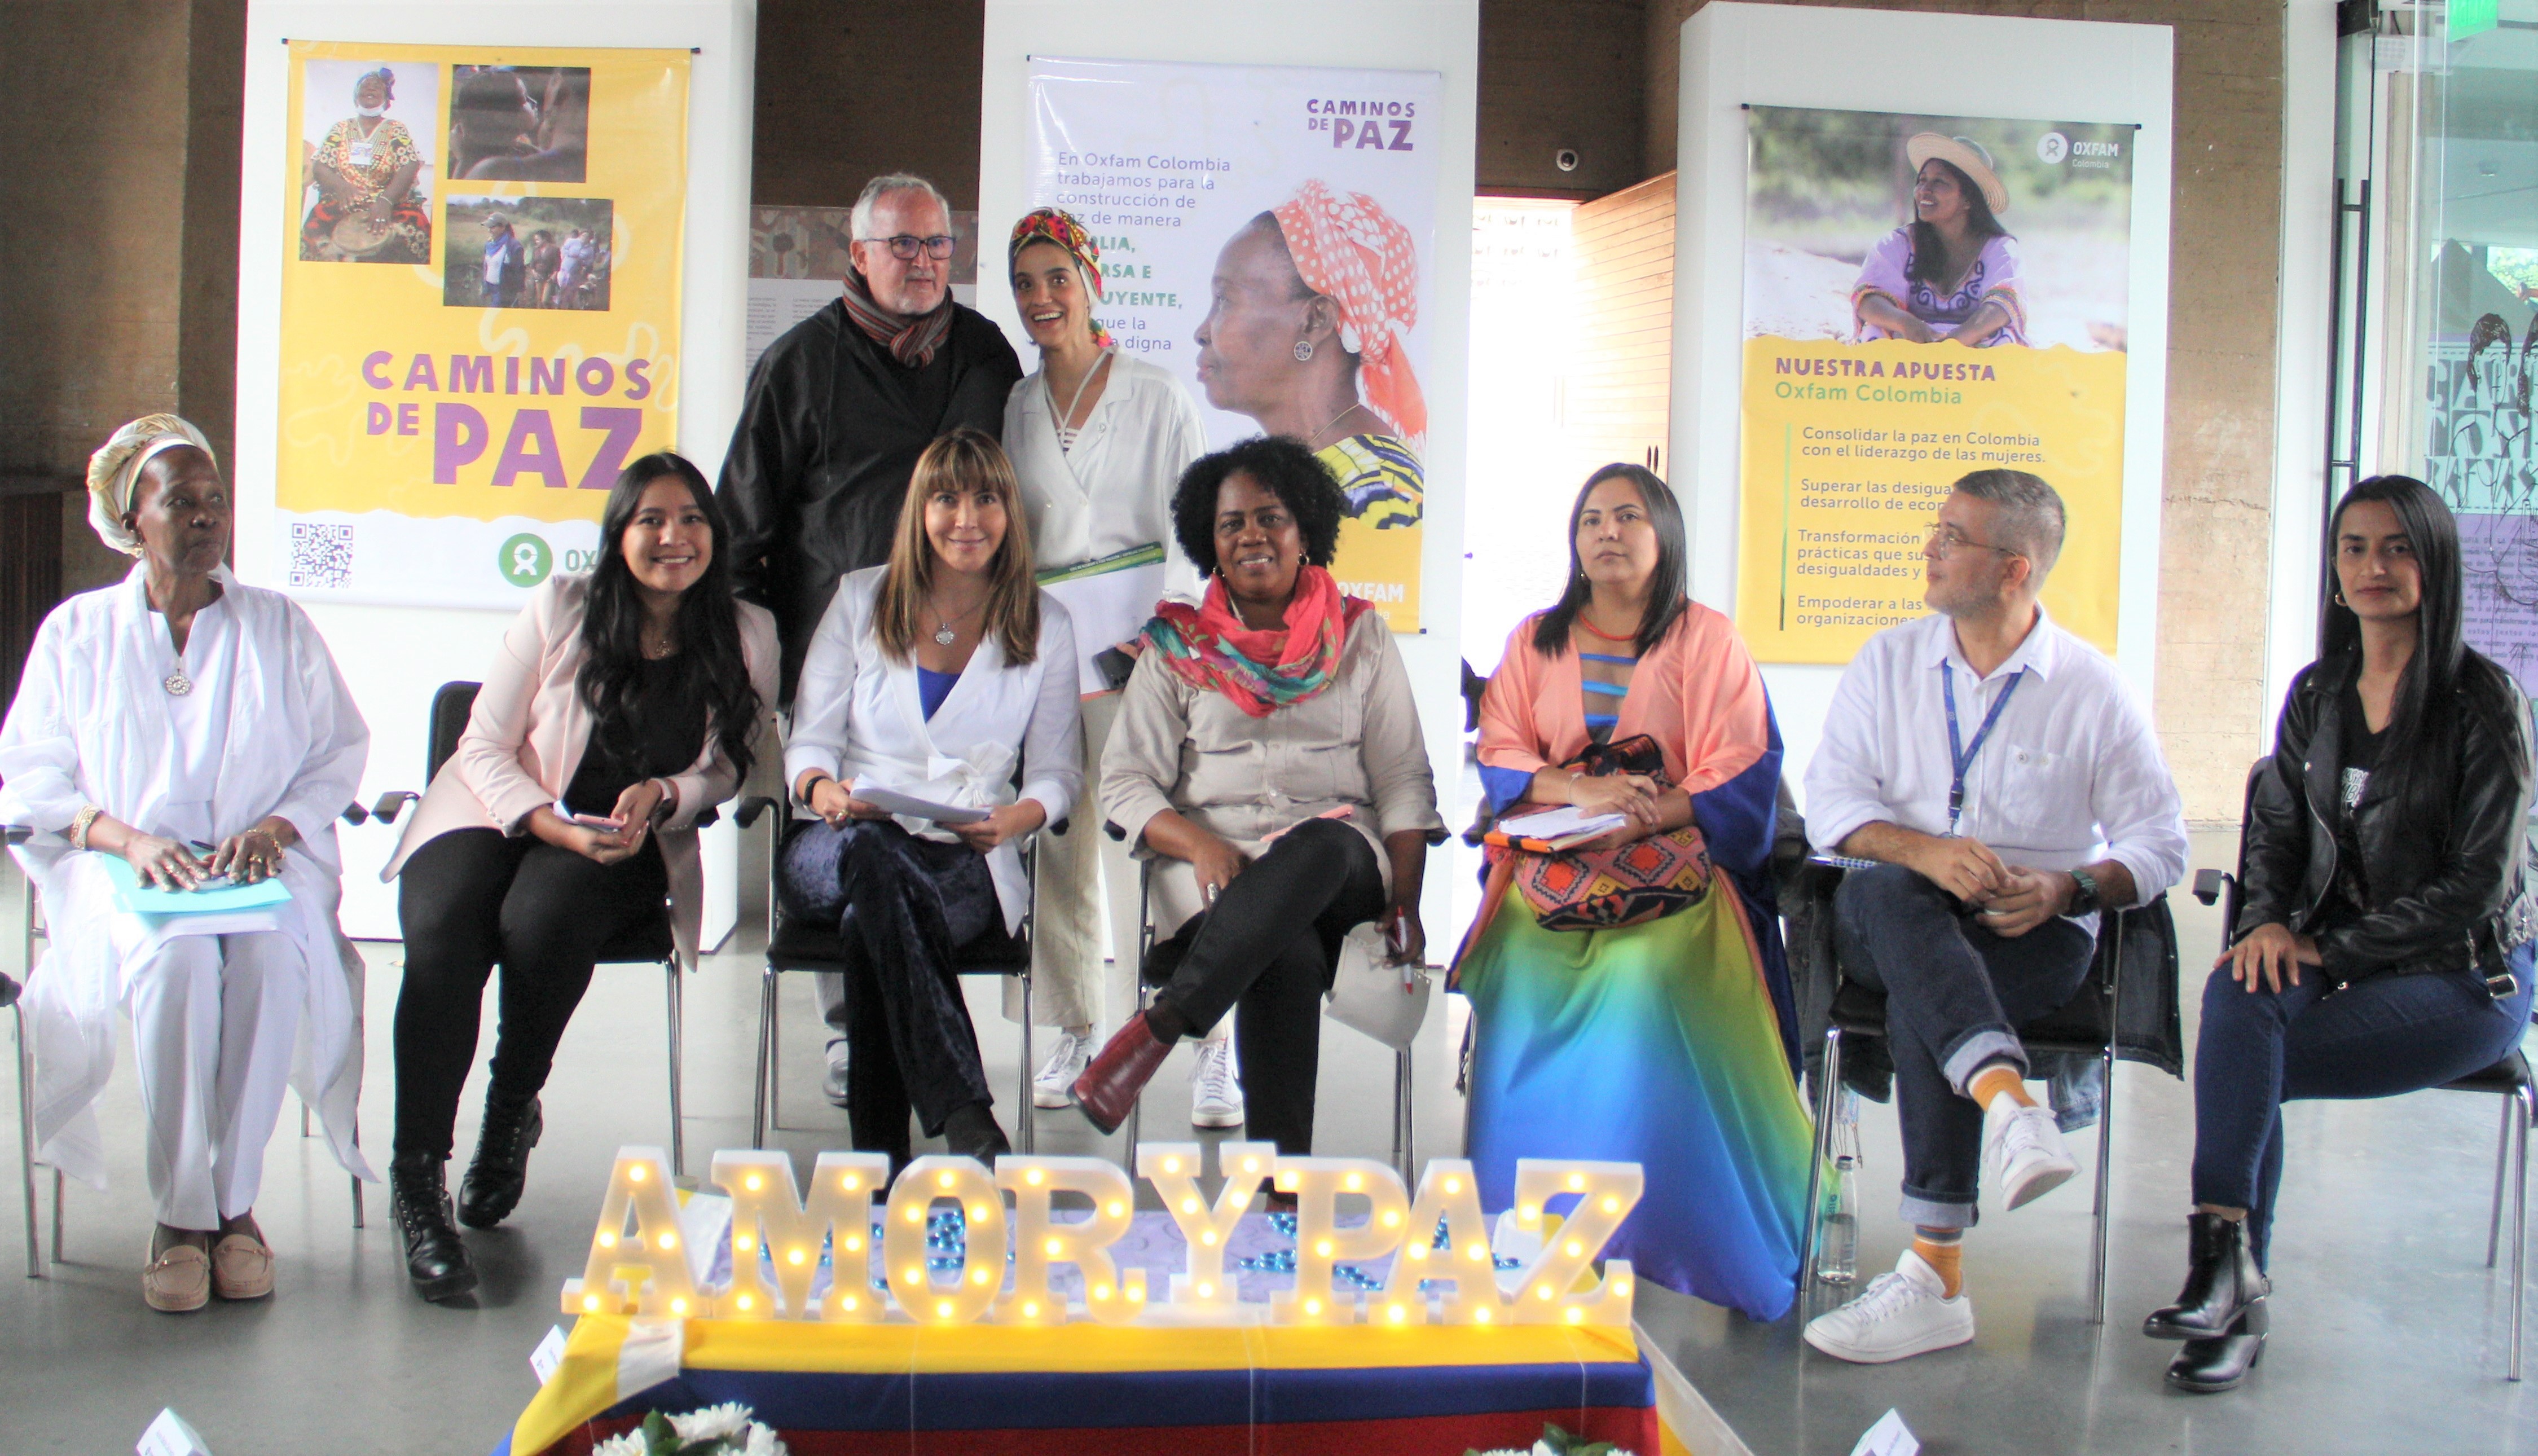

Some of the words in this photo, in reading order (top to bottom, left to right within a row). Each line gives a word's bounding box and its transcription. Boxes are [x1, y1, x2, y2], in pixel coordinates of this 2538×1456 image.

[1307, 99, 1415, 118] CAMINOS
[1308, 117, 1329, 131] DE
[1333, 118, 1414, 151] PAZ
[2073, 141, 2119, 157] OXFAM
[1058, 152, 1078, 166] En
[1085, 153, 1141, 168] Oxfam
[1147, 155, 1231, 171] Colombia
[2072, 159, 2110, 169] Colombia
[1057, 172, 1151, 189] trabajamos
[1158, 177, 1194, 191] para
[1201, 177, 1215, 190] la
[1056, 193, 1169, 208] construcción
[1176, 195, 1196, 208] de
[1091, 211, 1112, 225] de
[1118, 214, 1182, 227] manera
[1101, 263, 1136, 279] RSA
[1142, 265, 1151, 279] E
[1100, 291, 1182, 310] UYENTE,
[1132, 316, 1146, 330] la
[1125, 336, 1171, 353] digna
[362, 350, 651, 401] CAMINOS
[1775, 357, 1885, 378] NUESTRA
[1892, 362, 1996, 381] APUESTA
[1775, 381, 1848, 401] Oxfam
[1856, 384, 1962, 404] Colombia
[1803, 426, 1888, 442] Consolidar
[1893, 429, 1906, 443] la
[1911, 433, 1938, 445] paz
[1942, 434, 1961, 444] en
[1967, 432, 2040, 446] Colombia
[367, 402, 419, 436] DE
[433, 402, 643, 490] PAZ
[1802, 445, 1831, 456] con
[1836, 445, 1850, 457] el
[1855, 445, 1928, 461] liderazgo
[1933, 447, 1951, 460] de
[1956, 448, 1976, 460] las
[1981, 450, 2046, 465] mujeres.
[1801, 478, 1862, 494] Superar
[1867, 481, 1887, 493] las
[1893, 482, 1951, 498] desigua
[1800, 496, 1880, 509] desarrollo
[1885, 498, 1903, 510] de
[1797, 529, 1920, 544] Transformación
[1797, 546, 1868, 561] prácticas
[1873, 551, 1902, 562] que
[1796, 562, 1908, 578] desigualdades
[1912, 568, 1921, 580] y
[1797, 595, 1884, 610] Empoderar
[1888, 600, 1897, 610] a
[1902, 598, 1923, 610] las
[1796, 613, 1916, 627] organizacione
[561, 1145, 1146, 1326] AMOR
[1136, 1141, 1278, 1307] Y
[1269, 1155, 1644, 1326] PAZ
